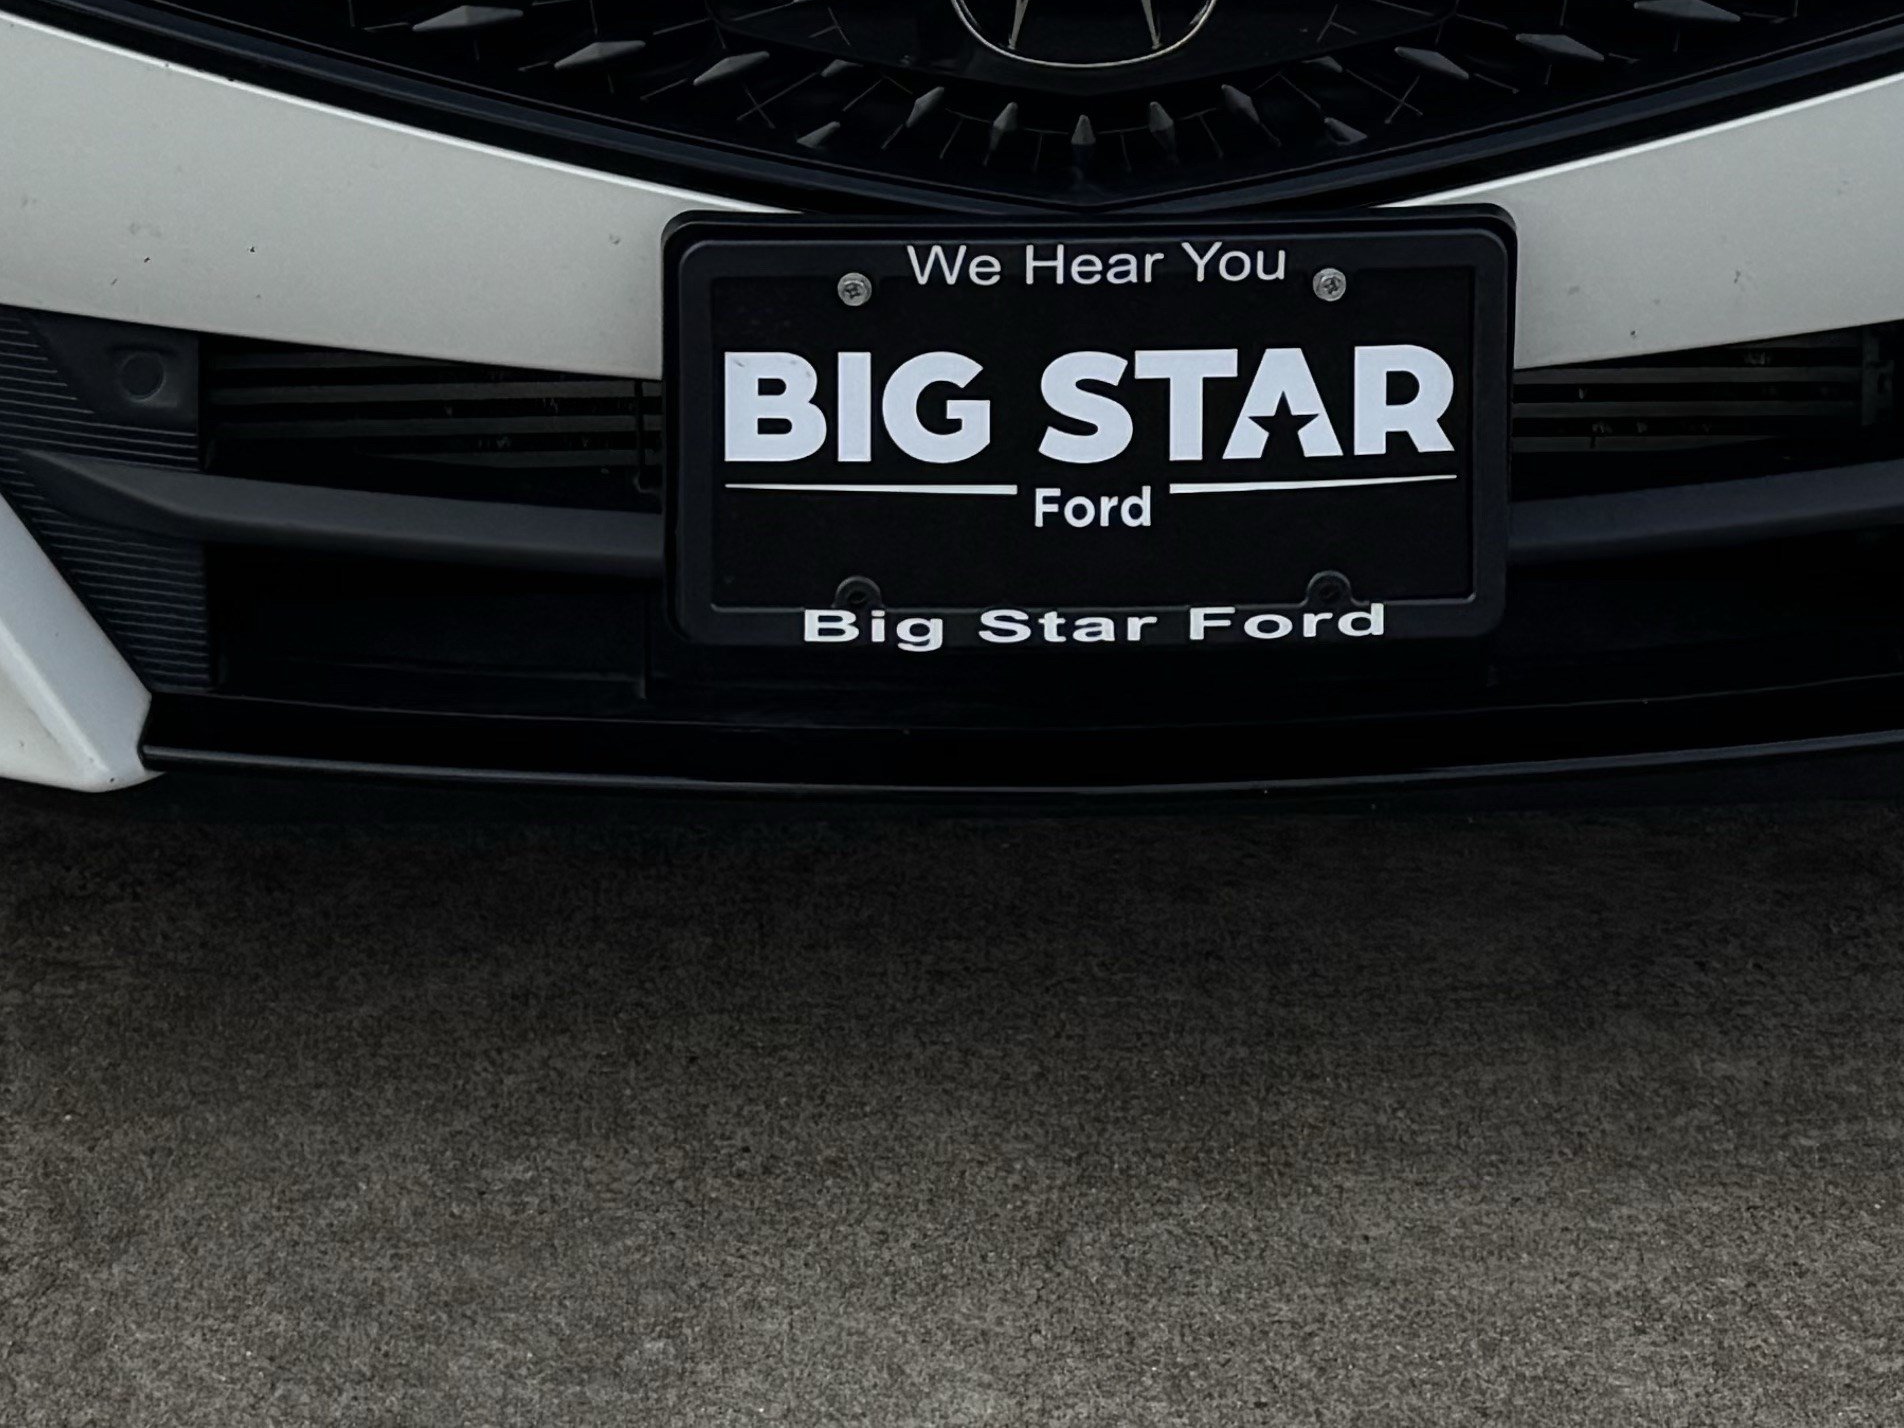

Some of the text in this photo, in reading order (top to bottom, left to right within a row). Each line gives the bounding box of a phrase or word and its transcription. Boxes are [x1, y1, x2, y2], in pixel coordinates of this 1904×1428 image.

[906, 241, 1286, 286] We Hear You
[724, 344, 1455, 464] BIG STAR
[1034, 485, 1152, 528] Ford
[803, 602, 1385, 653] Big Star Ford
